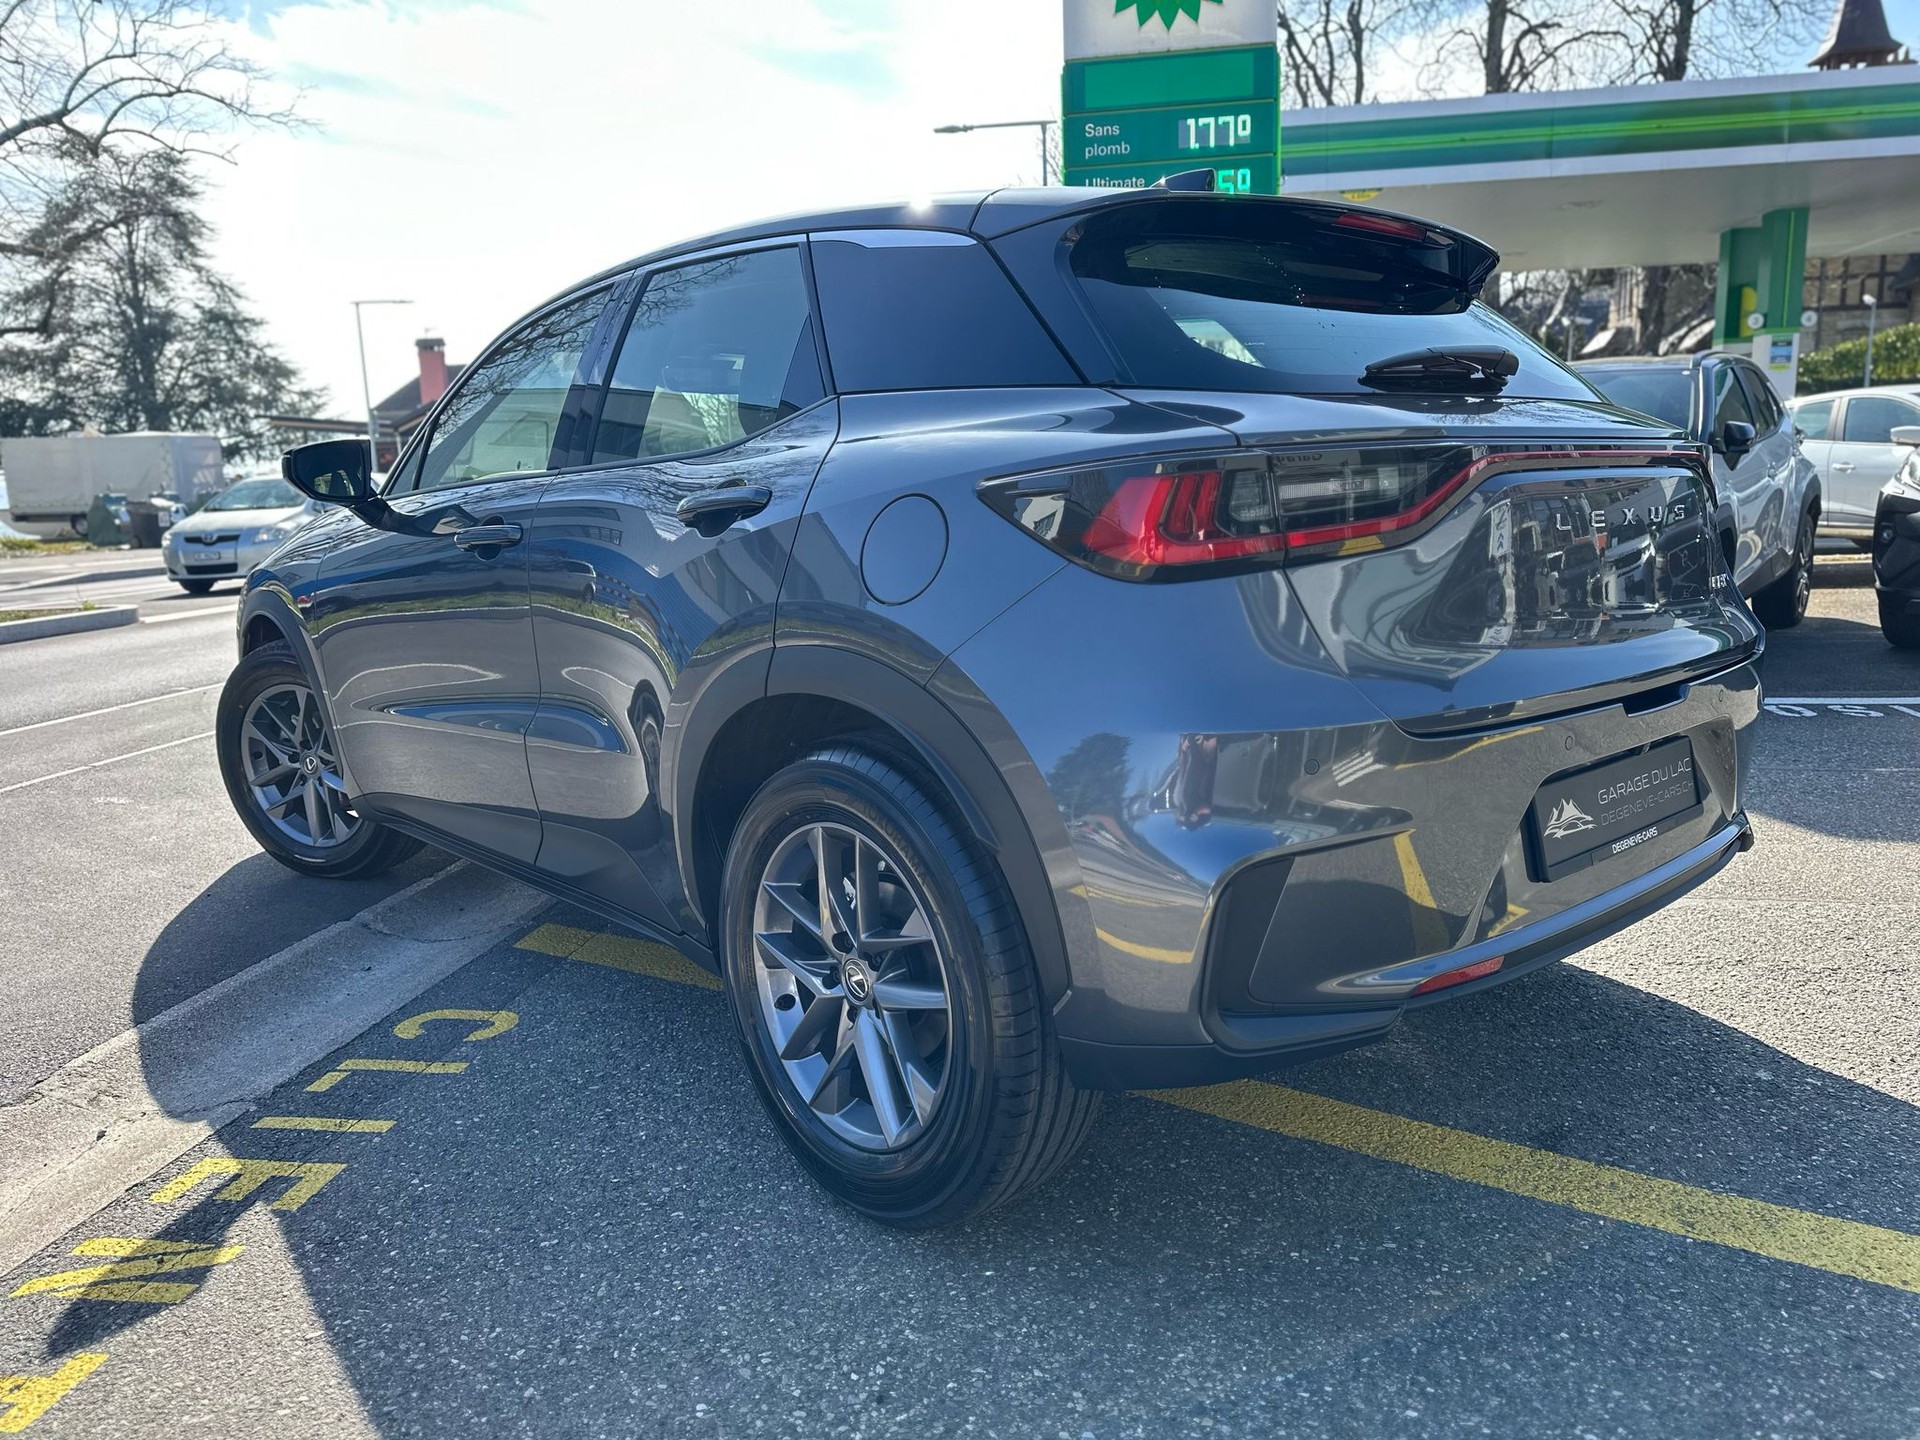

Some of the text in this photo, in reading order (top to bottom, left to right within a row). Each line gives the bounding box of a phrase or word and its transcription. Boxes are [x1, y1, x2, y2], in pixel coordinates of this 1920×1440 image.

[1085, 123, 1120, 137] Sans
[1085, 141, 1131, 160] plomb
[1085, 176, 1145, 188] Ultimate
[1556, 504, 1685, 531] LEXUS
[1597, 757, 1692, 805] GARAGE DU LAC
[1611, 827, 1658, 854] DEGENEVE-CARS
